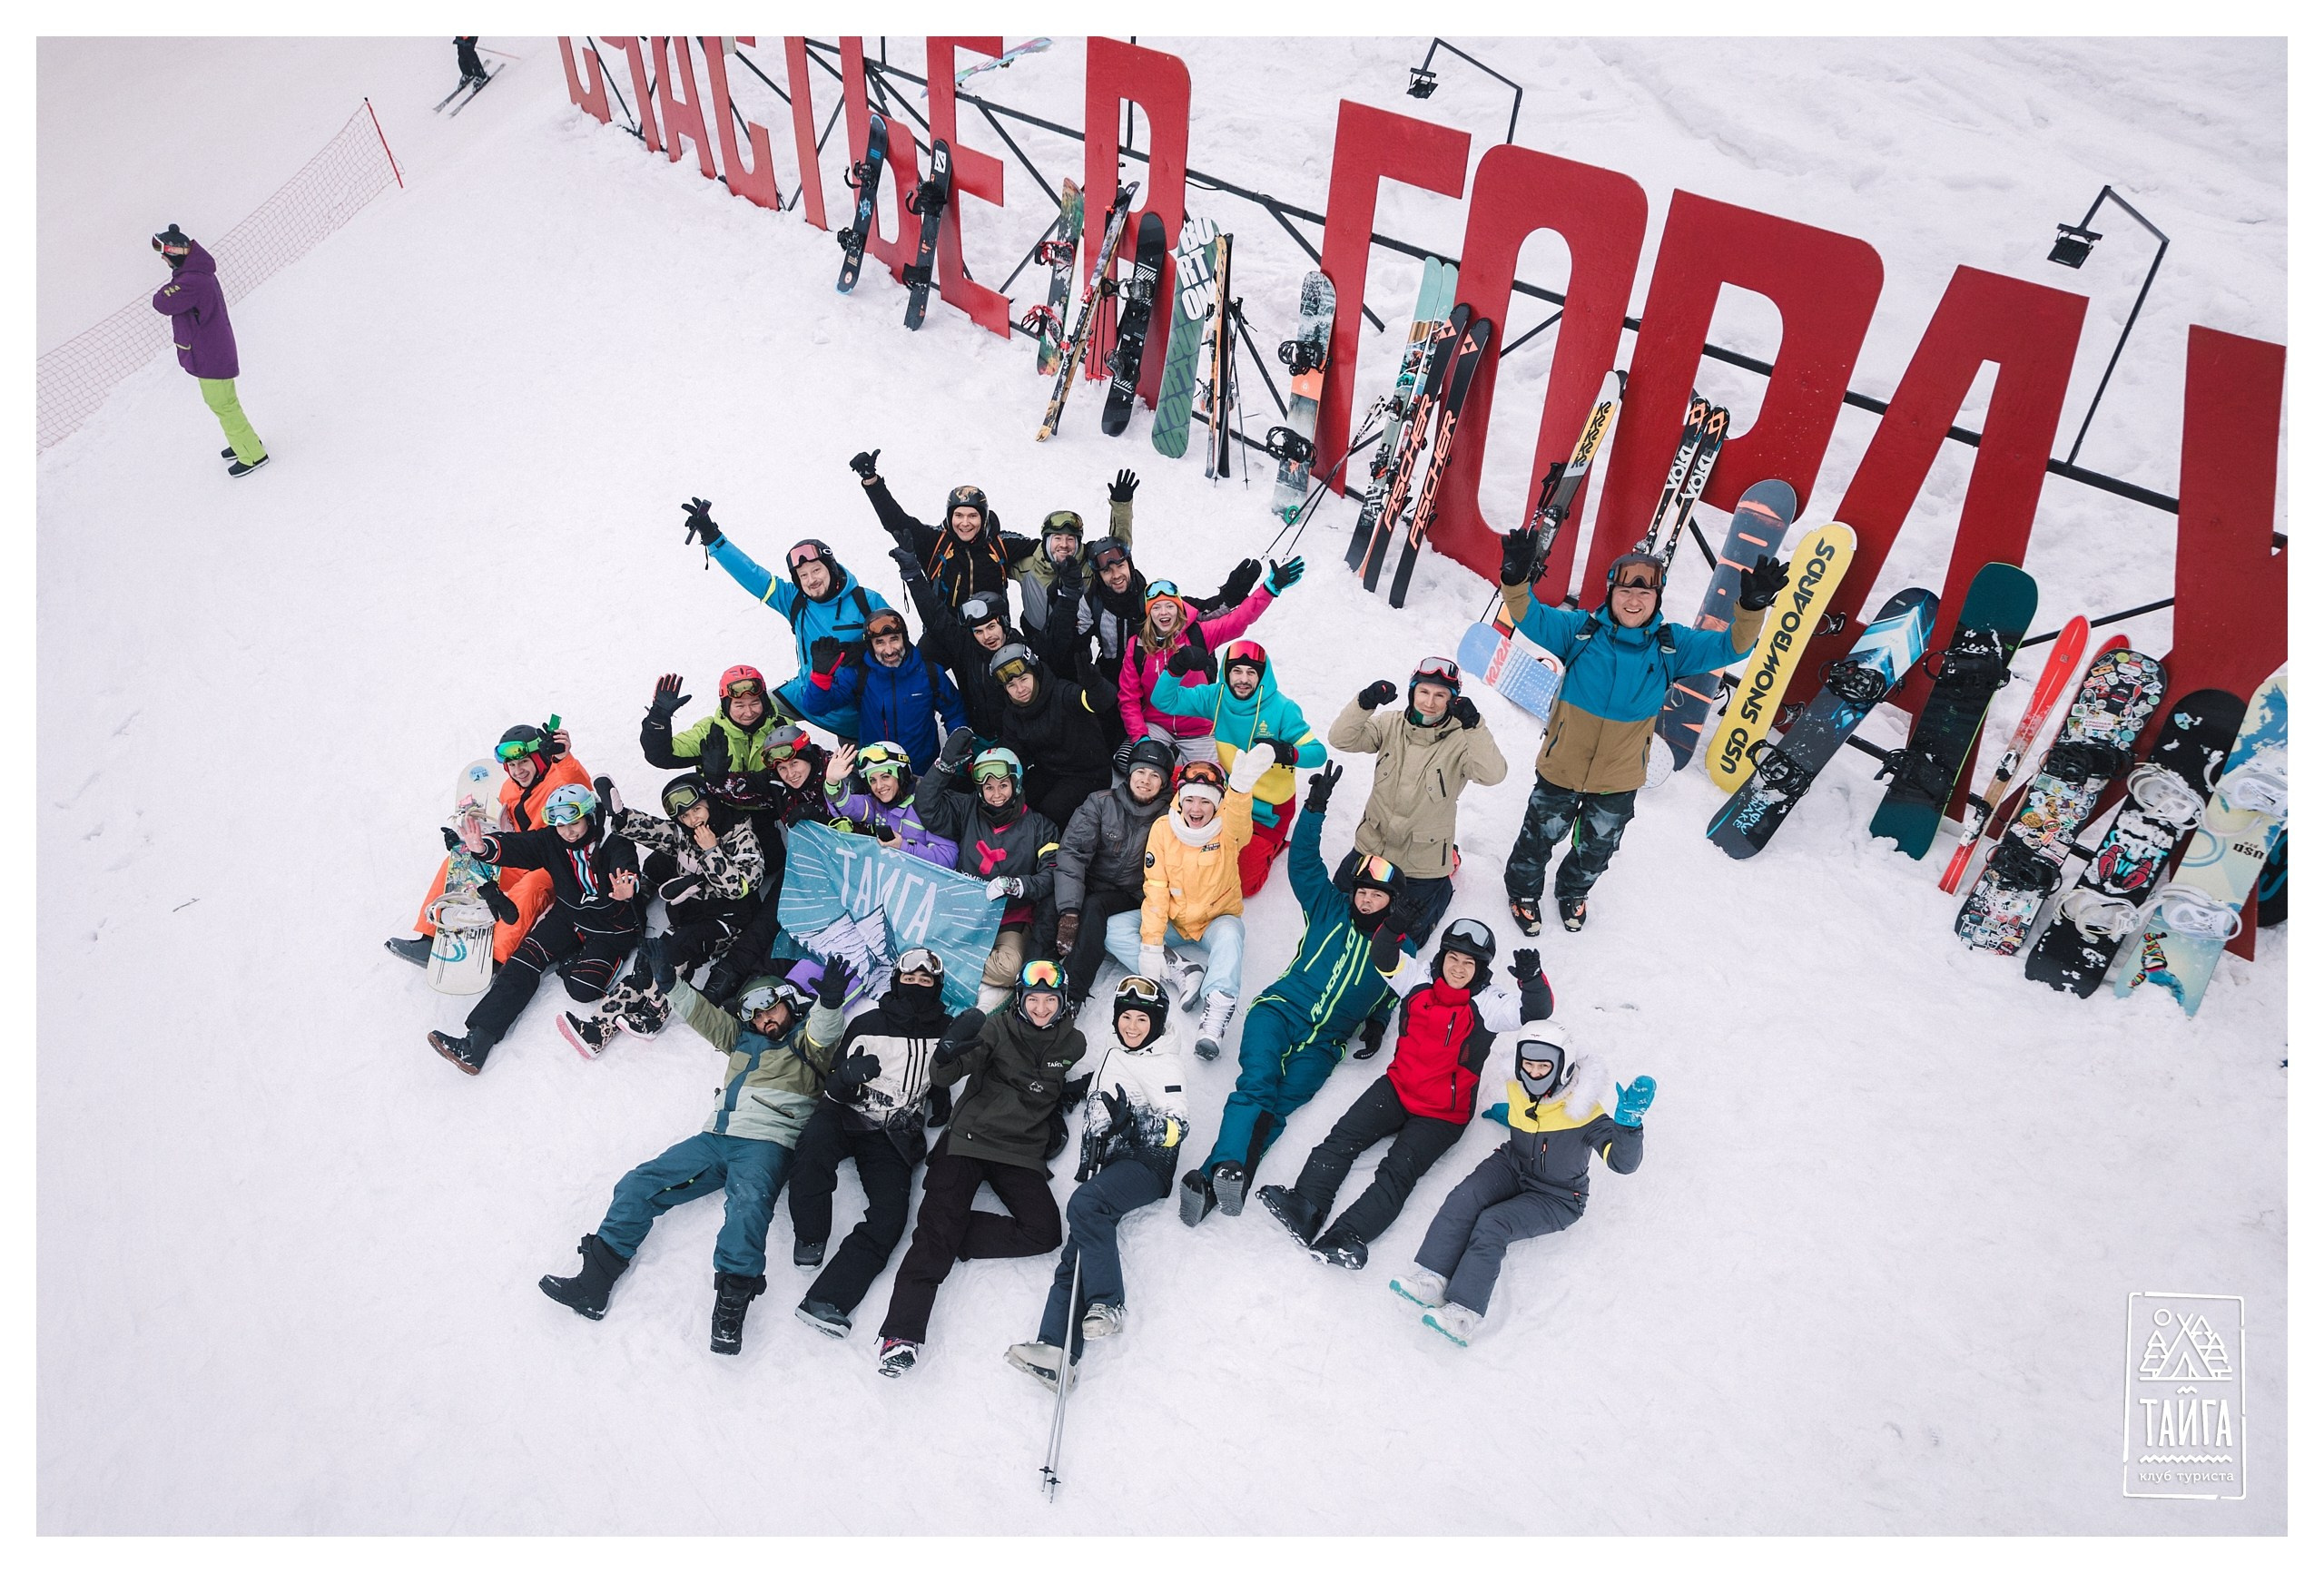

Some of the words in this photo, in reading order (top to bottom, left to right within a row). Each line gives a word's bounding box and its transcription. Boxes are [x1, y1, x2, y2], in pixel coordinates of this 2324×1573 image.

[1384, 393, 1434, 532] FISCHER
[1409, 409, 1457, 550] FISCHER
[1719, 727, 1749, 774] USD
[1740, 537, 1836, 725] SNOWBOARDS
[835, 847, 938, 945] ТАЙГА
